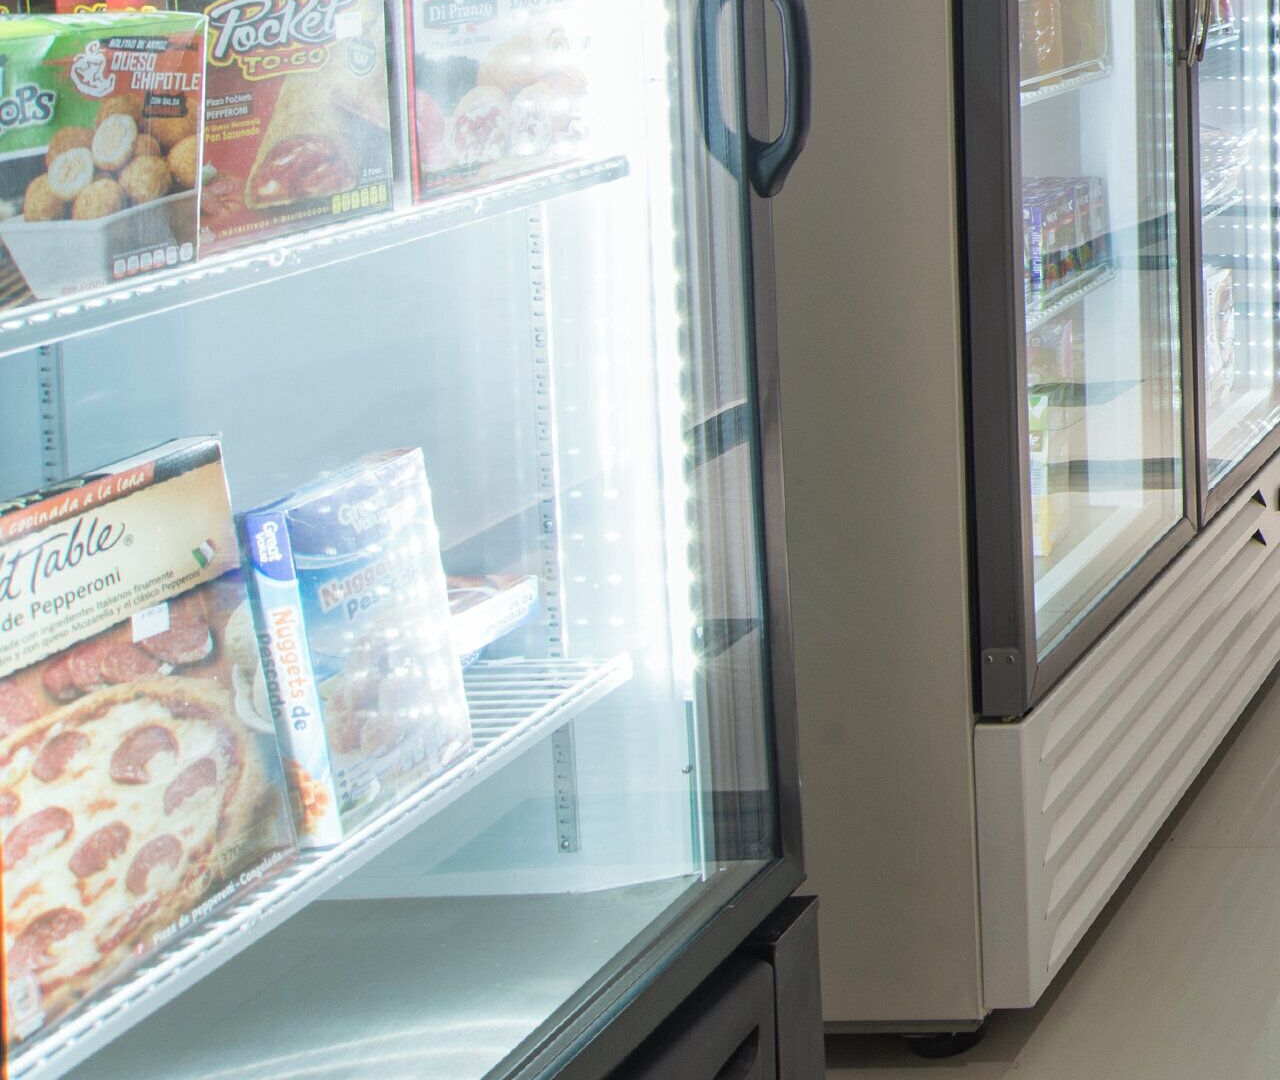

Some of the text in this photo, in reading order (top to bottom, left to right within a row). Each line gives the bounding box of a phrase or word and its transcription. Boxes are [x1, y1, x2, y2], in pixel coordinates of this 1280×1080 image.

[429, 2, 492, 22] Di Pranzo
[111, 51, 157, 71] QUESO
[131, 72, 201, 91] CHIPOTLE
[207, 106, 248, 120] PEPPERONI
[8, 497, 79, 536] cocinada
[83, 493, 93, 507] a
[98, 484, 113, 501] la
[263, 520, 282, 563] Great
[2, 567, 122, 633] de Pepperoni
[41, 607, 95, 634] ingredientes
[133, 570, 175, 595] finamente
[257, 632, 287, 719] Pescado
[271, 608, 311, 732] Nuggets de
[191, 880, 236, 923] pepperoni
